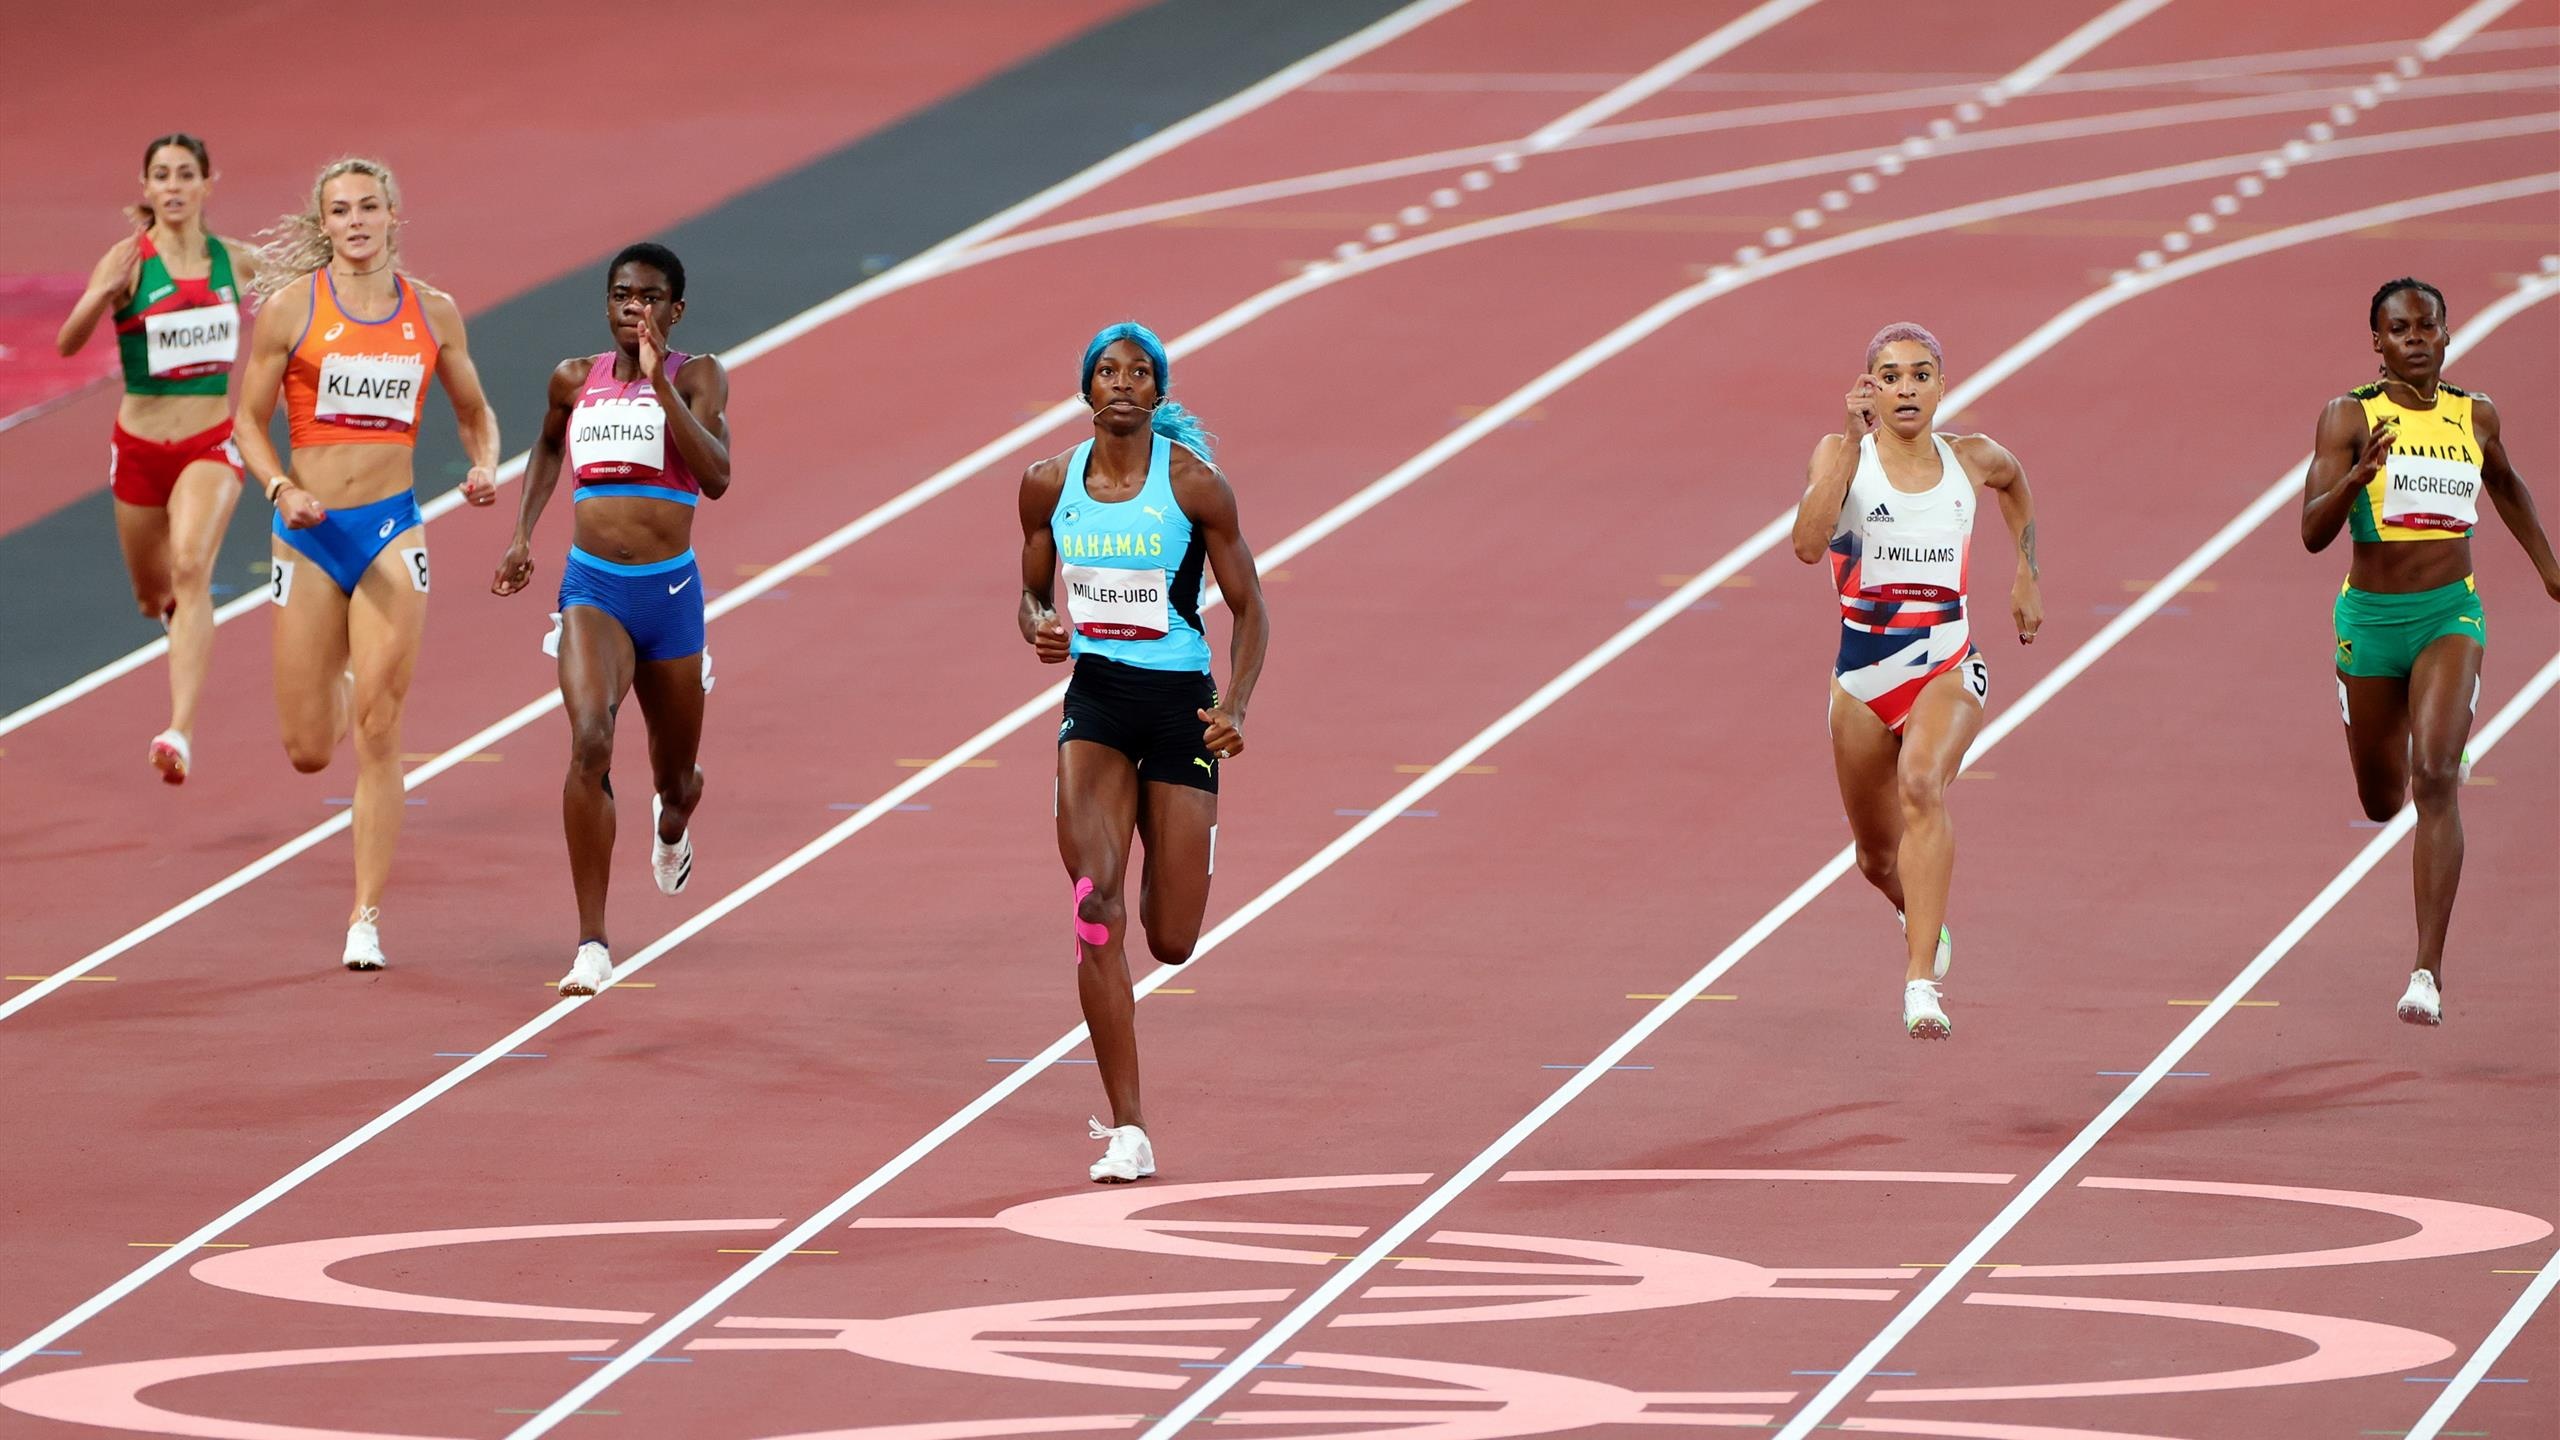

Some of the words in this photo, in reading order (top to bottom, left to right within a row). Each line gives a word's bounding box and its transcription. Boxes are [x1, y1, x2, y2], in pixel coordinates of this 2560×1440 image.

[159, 321, 230, 349] MORAN
[327, 374, 411, 399] KLAVER
[576, 424, 655, 443] JONATHAS
[2393, 473, 2474, 498] McGREGOR
[1866, 514, 1895, 523] adidas
[1062, 533, 1162, 558] BAHAMAS
[1874, 546, 1955, 563] J.WILLIAMS
[414, 552, 427, 587] 8
[1073, 582, 1158, 603] MILLER-UIBO
[1909, 588, 1921, 596] 2020
[1092, 627, 1107, 635] TOKYO
[1973, 663, 1986, 697] 5
